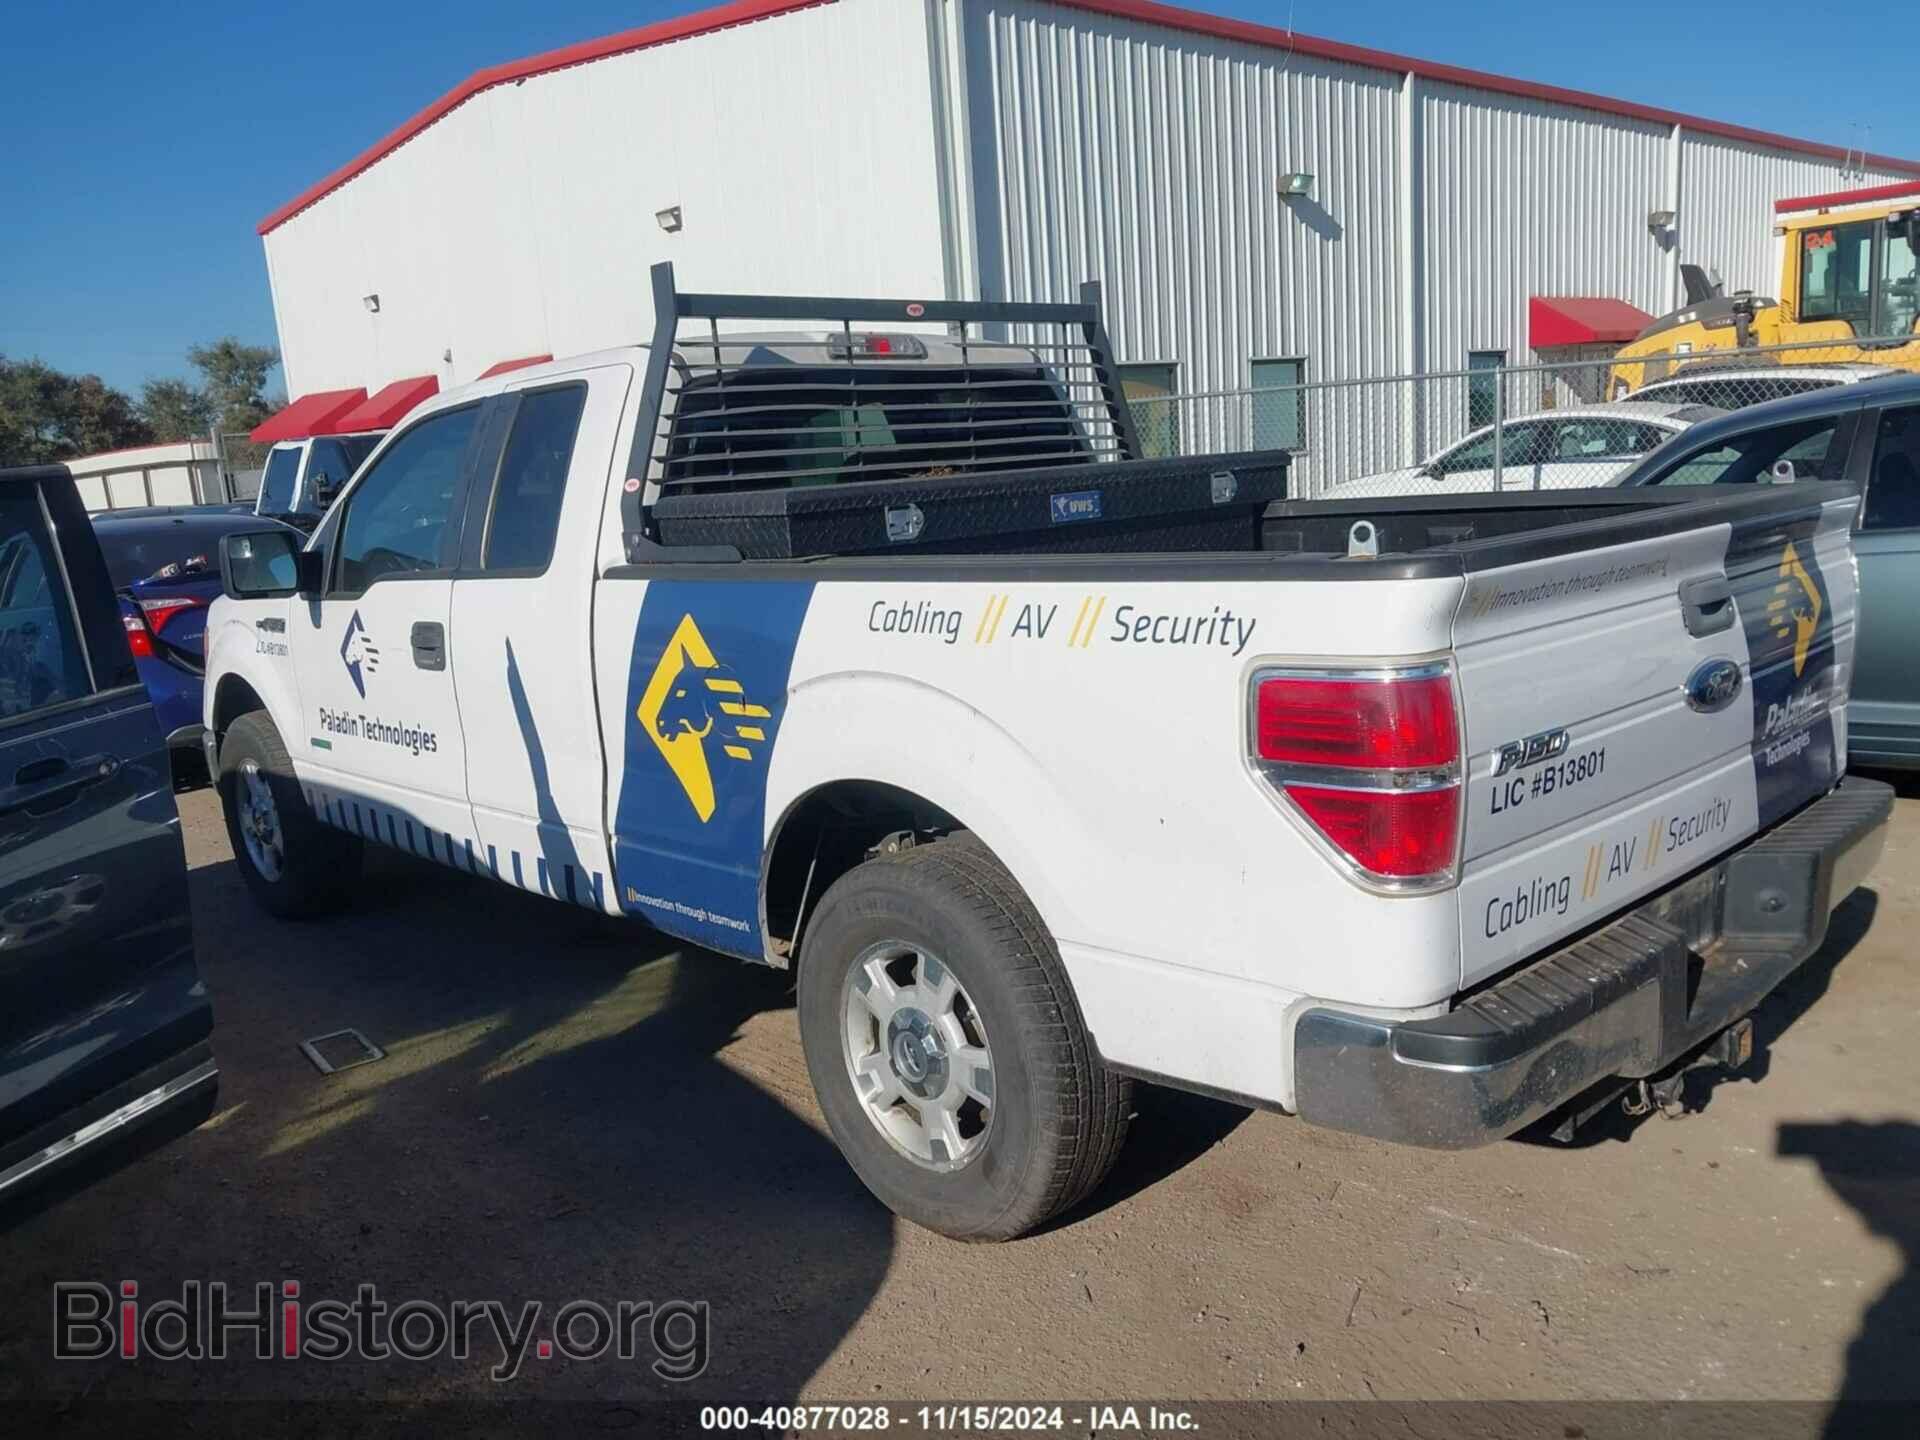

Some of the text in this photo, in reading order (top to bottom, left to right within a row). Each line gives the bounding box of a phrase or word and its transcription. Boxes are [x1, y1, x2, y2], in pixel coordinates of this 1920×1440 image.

[868, 600, 963, 644] Cabling
[1010, 604, 1058, 639] AV
[1110, 605, 1257, 657] Security
[319, 707, 438, 756] Paladin Technologies
[1491, 747, 1605, 815] LIC #B13801
[1485, 876, 1571, 938] Cabling
[1608, 836, 1637, 881] AV
[1667, 798, 1732, 852] Security
[675, 902, 708, 922] through
[708, 911, 751, 933] teamwork
